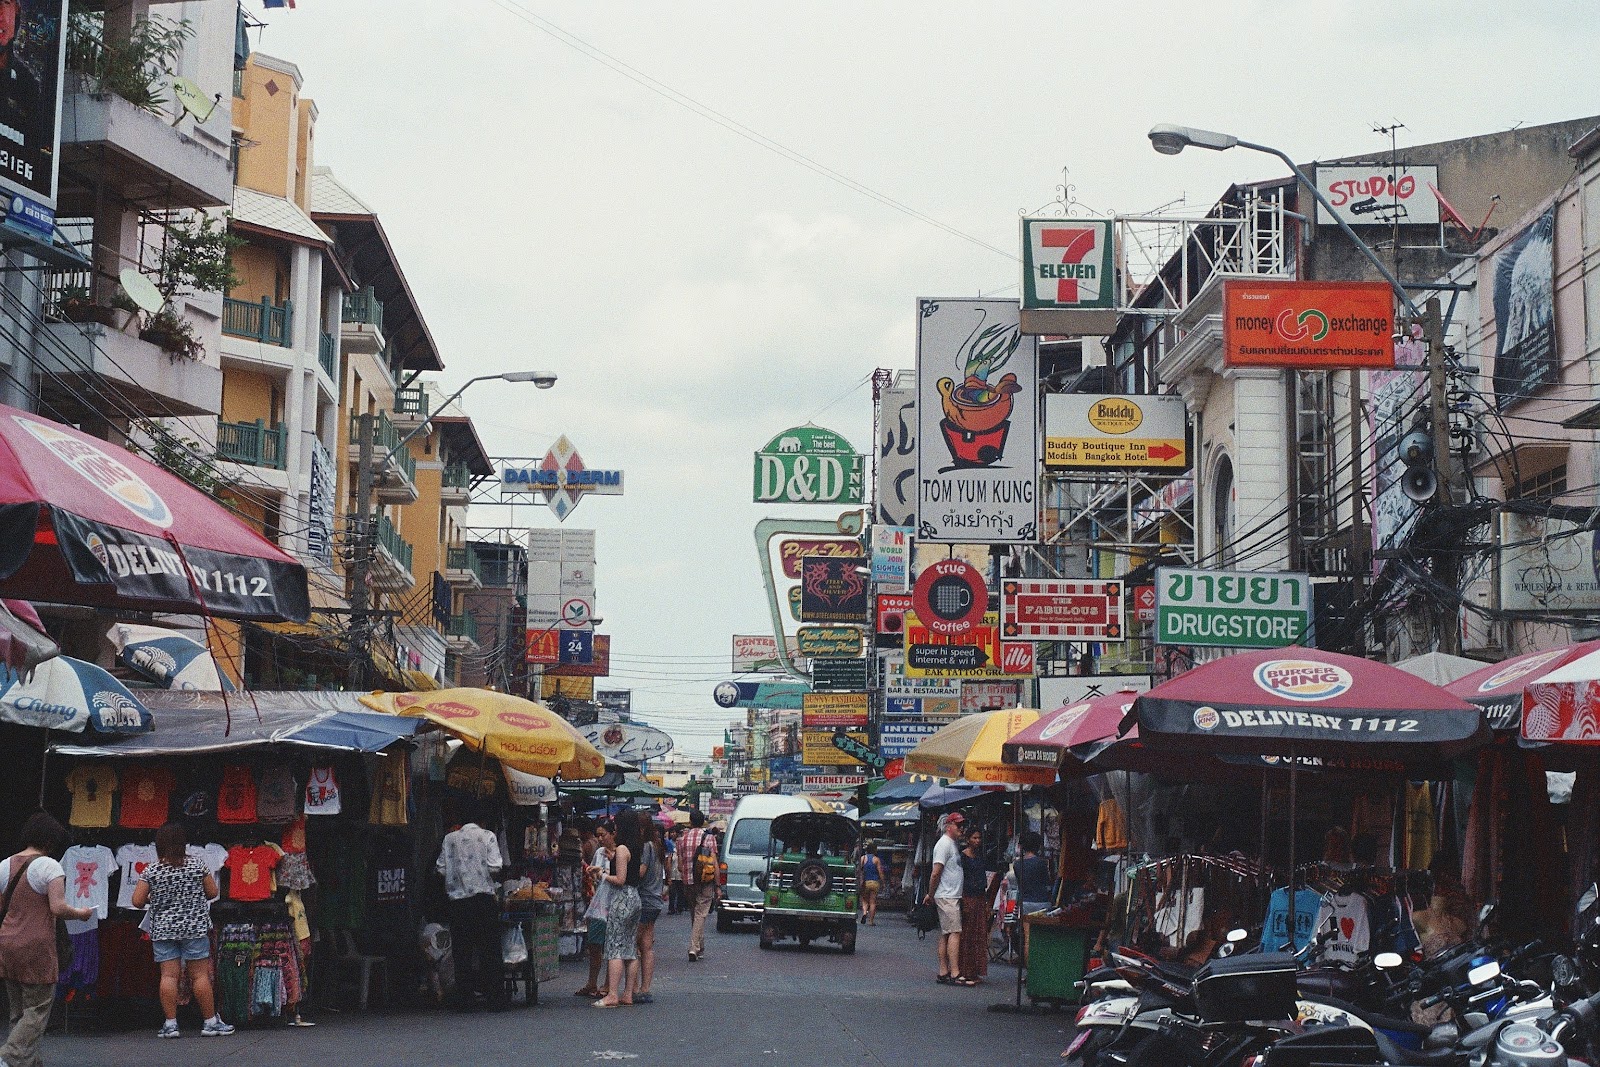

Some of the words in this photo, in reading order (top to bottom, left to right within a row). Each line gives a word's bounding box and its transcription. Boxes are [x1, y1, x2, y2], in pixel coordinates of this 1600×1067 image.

[1041, 228, 1095, 302] 7
[1235, 316, 1274, 334] money
[1331, 314, 1387, 335] exchange
[1098, 404, 1135, 421] Buddy
[1047, 442, 1078, 451] Buddy
[1082, 442, 1125, 452] Boutique
[1129, 442, 1146, 451] Inn
[1047, 451, 1078, 460] Modish
[1085, 451, 1121, 462] Bangkok
[1124, 452, 1148, 461] Hotel
[504, 468, 557, 483] DANG
[567, 470, 620, 485] DERM
[758, 455, 844, 502] D&D
[848, 457, 862, 499] INN
[923, 479, 952, 503] TOM
[957, 479, 987, 503] YUM
[992, 480, 1033, 503] KUNG
[942, 508, 1013, 536] ต้มยำกุ้ง
[880, 546, 903, 554] WORLD
[887, 555, 903, 563] JOIN
[936, 564, 967, 575] true
[211, 570, 275, 597] 1112
[1167, 573, 1300, 606] ขายยา
[1052, 597, 1072, 605] THE
[1025, 606, 1099, 615] FABULOUS
[932, 619, 970, 633] coffee
[1167, 612, 1300, 640] DRUGSTORE
[568, 641, 583, 652] 24
[915, 647, 938, 656] super
[940, 647, 948, 656] hi
[950, 648, 975, 657] speed
[915, 656, 947, 664] internet
[971, 657, 976, 665] fi
[1005, 647, 1032, 671] illy
[945, 669, 983, 677] TATTOO
[1267, 667, 1335, 679] BURGER
[1271, 673, 1340, 690] KING
[13, 696, 77, 721] Chang
[1486, 704, 1512, 719] 1112
[1221, 709, 1344, 731] DELIVERY
[1348, 717, 1420, 732] 1112
[805, 776, 844, 784] INTERNET
[845, 776, 865, 784] CAFE
[127, 861, 134, 878] I
